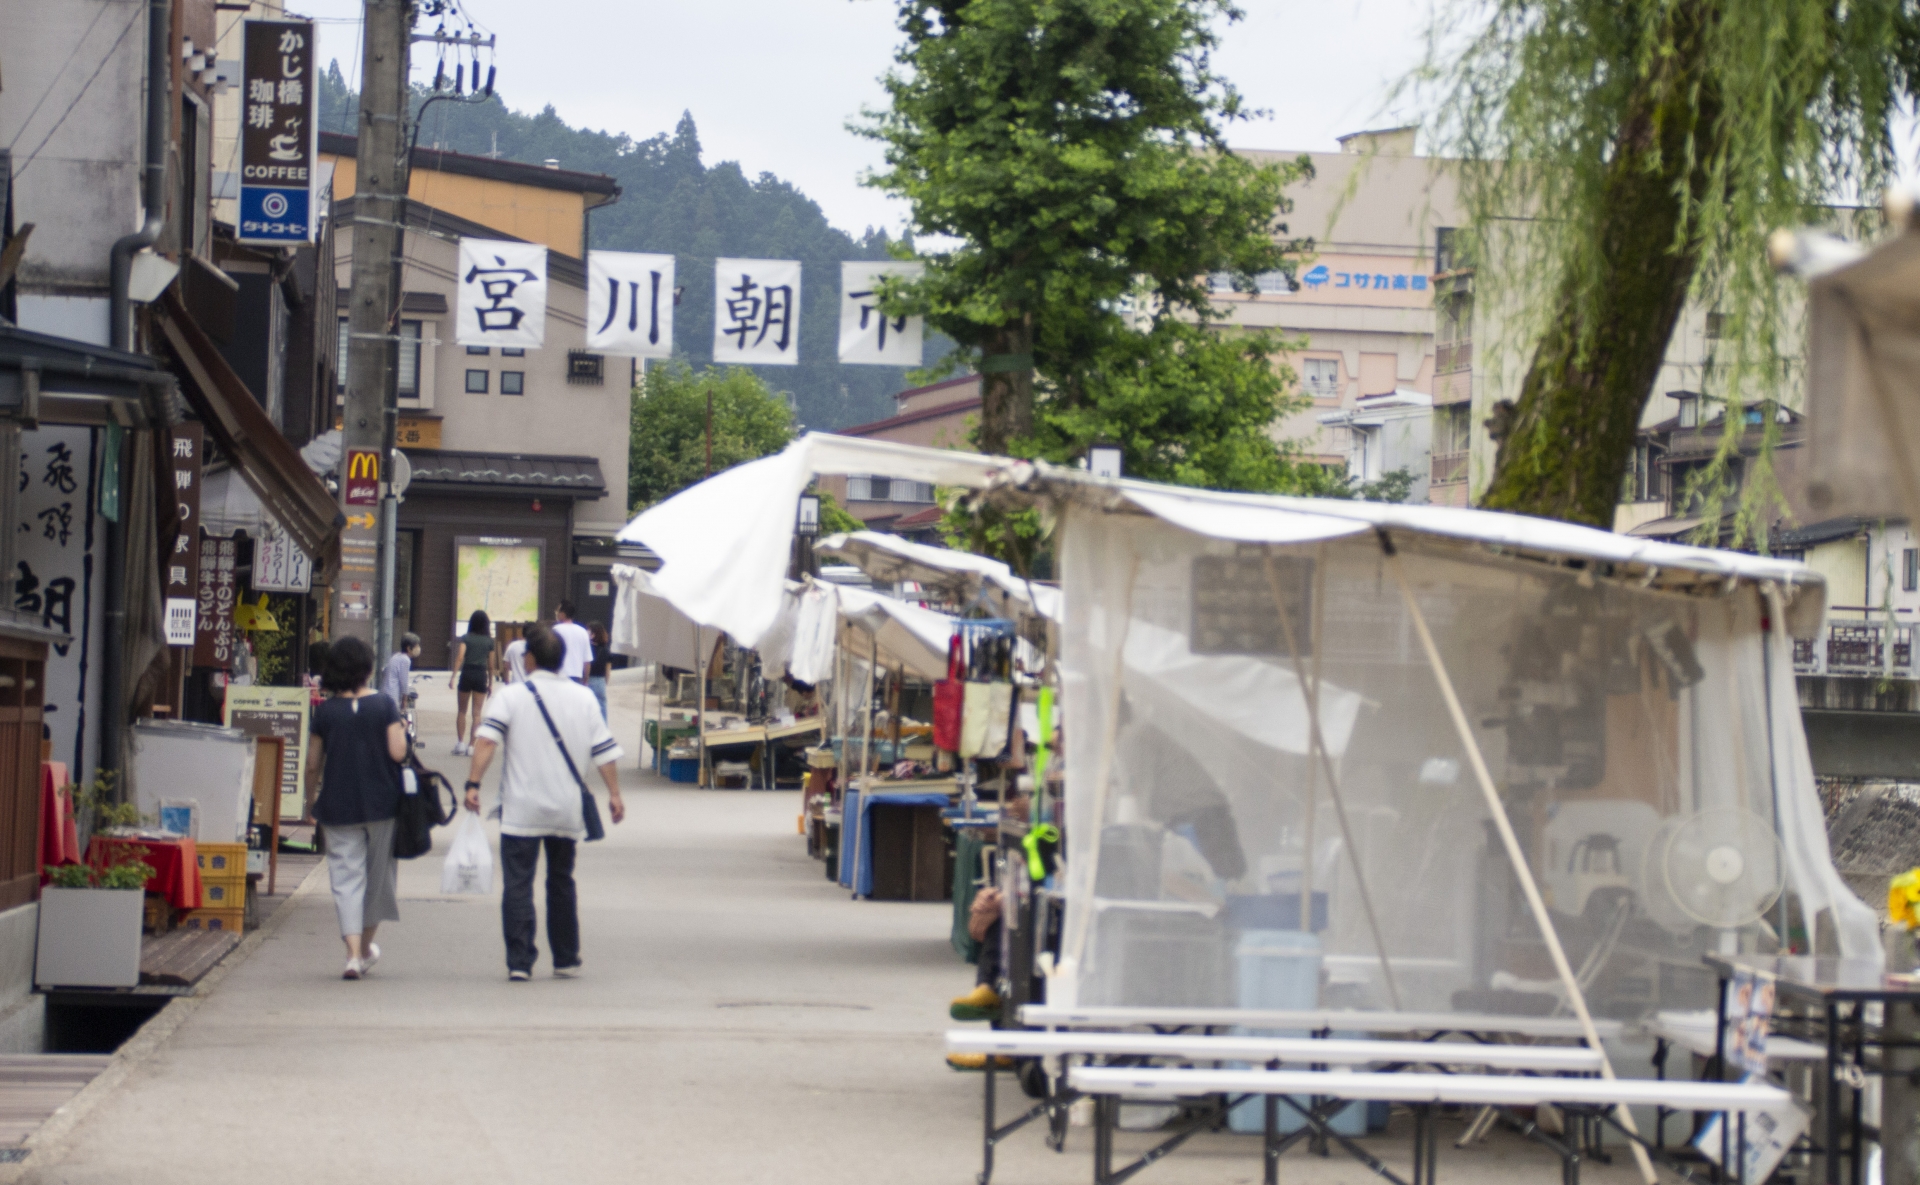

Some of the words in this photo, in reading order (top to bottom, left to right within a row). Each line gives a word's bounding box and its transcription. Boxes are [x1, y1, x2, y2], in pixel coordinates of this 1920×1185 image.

[249, 78, 274, 130] 珈琲
[279, 29, 304, 105] かじ橋
[244, 164, 309, 181] COFFEE
[168, 437, 194, 587] 飛騨の家具
[199, 541, 217, 631] 飛騨牛うどん
[214, 541, 235, 661] 飛騨牛のどんぶり
